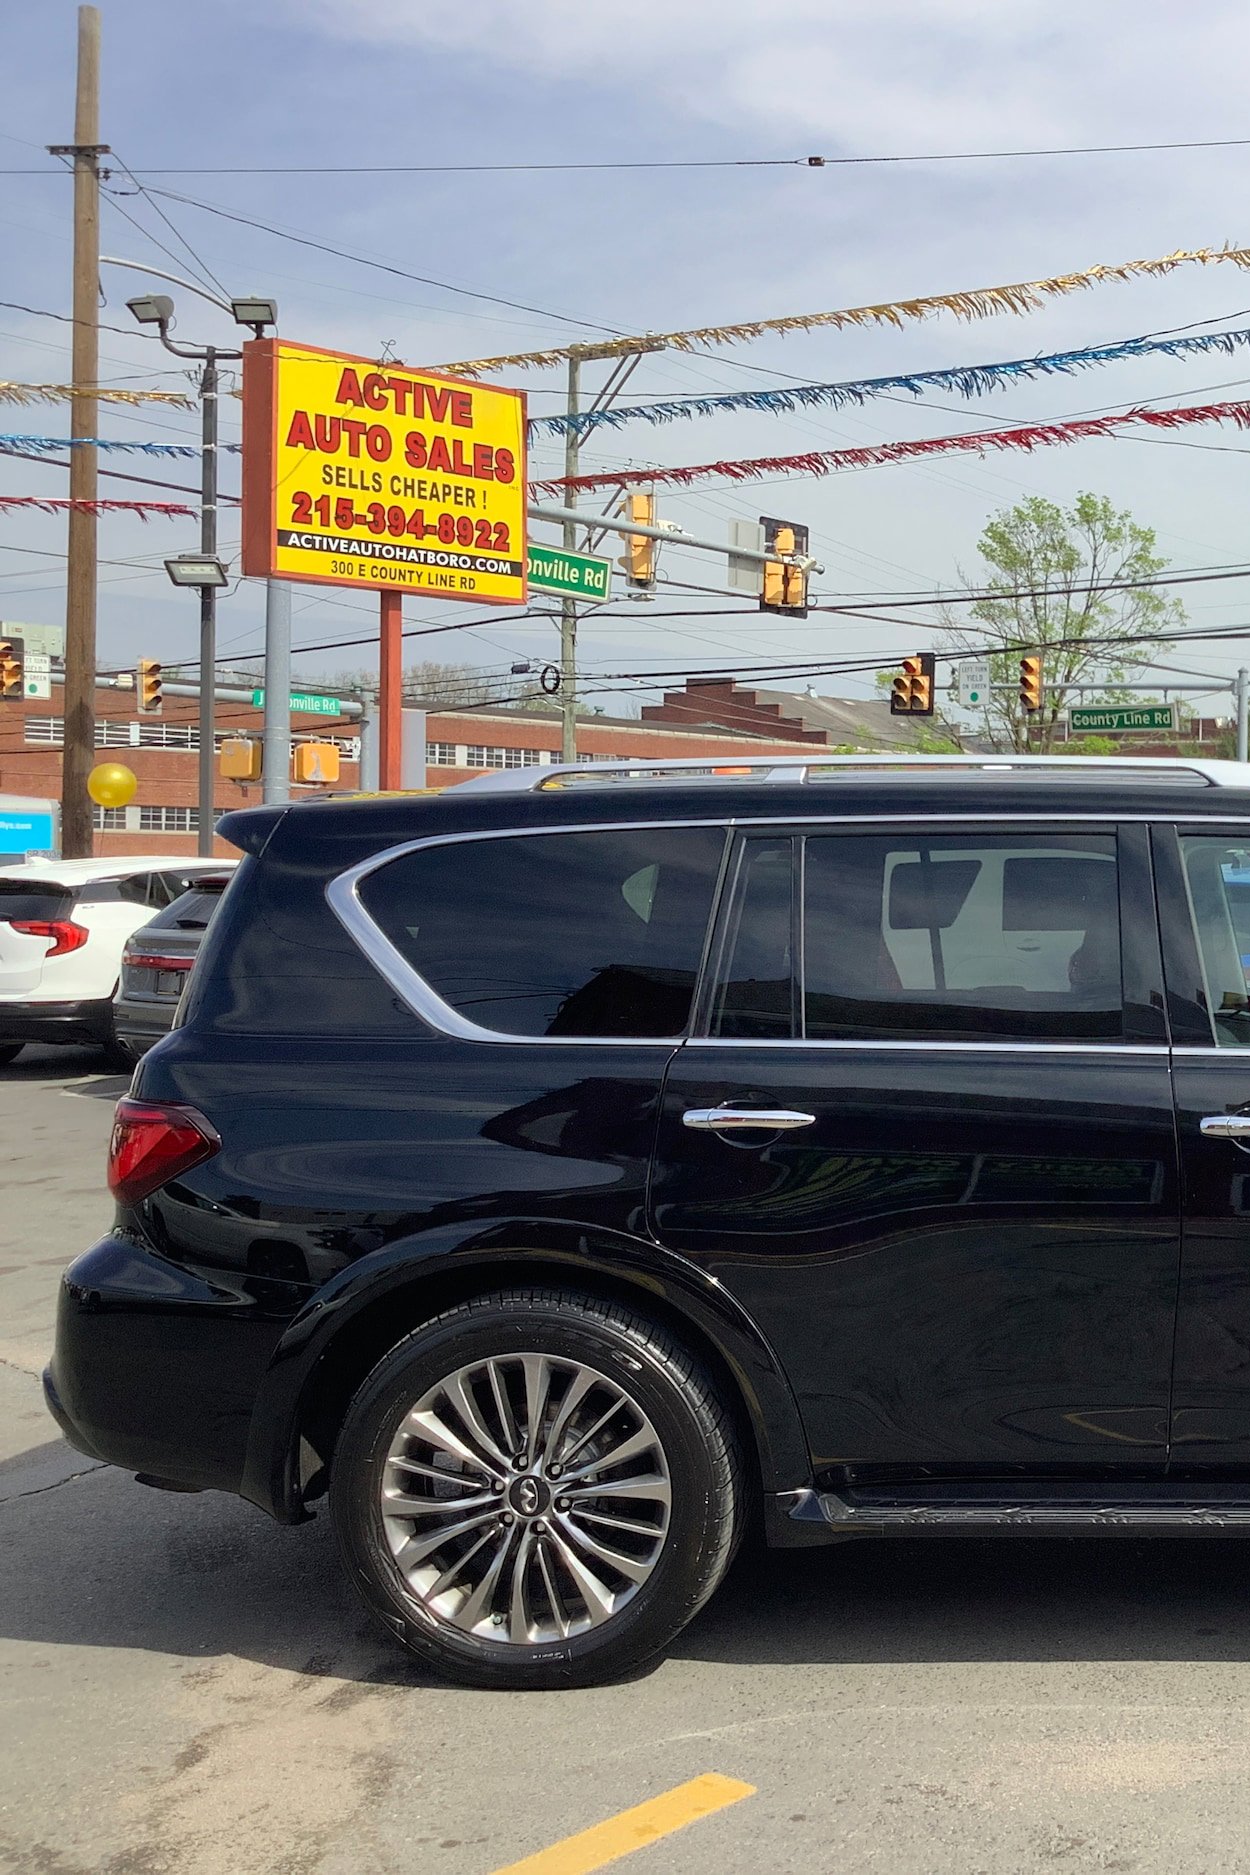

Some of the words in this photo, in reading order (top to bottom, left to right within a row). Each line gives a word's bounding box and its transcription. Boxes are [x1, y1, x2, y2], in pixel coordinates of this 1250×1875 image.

[335, 367, 473, 429] ACTIVE
[286, 410, 392, 462] AUTO
[405, 431, 515, 484] SALES
[322, 464, 382, 493] SELLS
[390, 475, 476, 508] CHEAPER
[291, 491, 510, 553] 215-394-8922
[288, 533, 512, 574] ACTIVEAUTOHATBORO.COM
[527, 558, 579, 583] onville
[584, 568, 604, 589] Rd
[331, 560, 353, 575] 300
[359, 564, 366, 577] E
[371, 565, 423, 586] COUNTY
[428, 572, 456, 588] LINE
[460, 577, 476, 590] RD
[322, 699, 336, 712] Rd
[1073, 713, 1119, 728] County
[1124, 711, 1150, 725] Line
[1154, 711, 1171, 725] Rd
